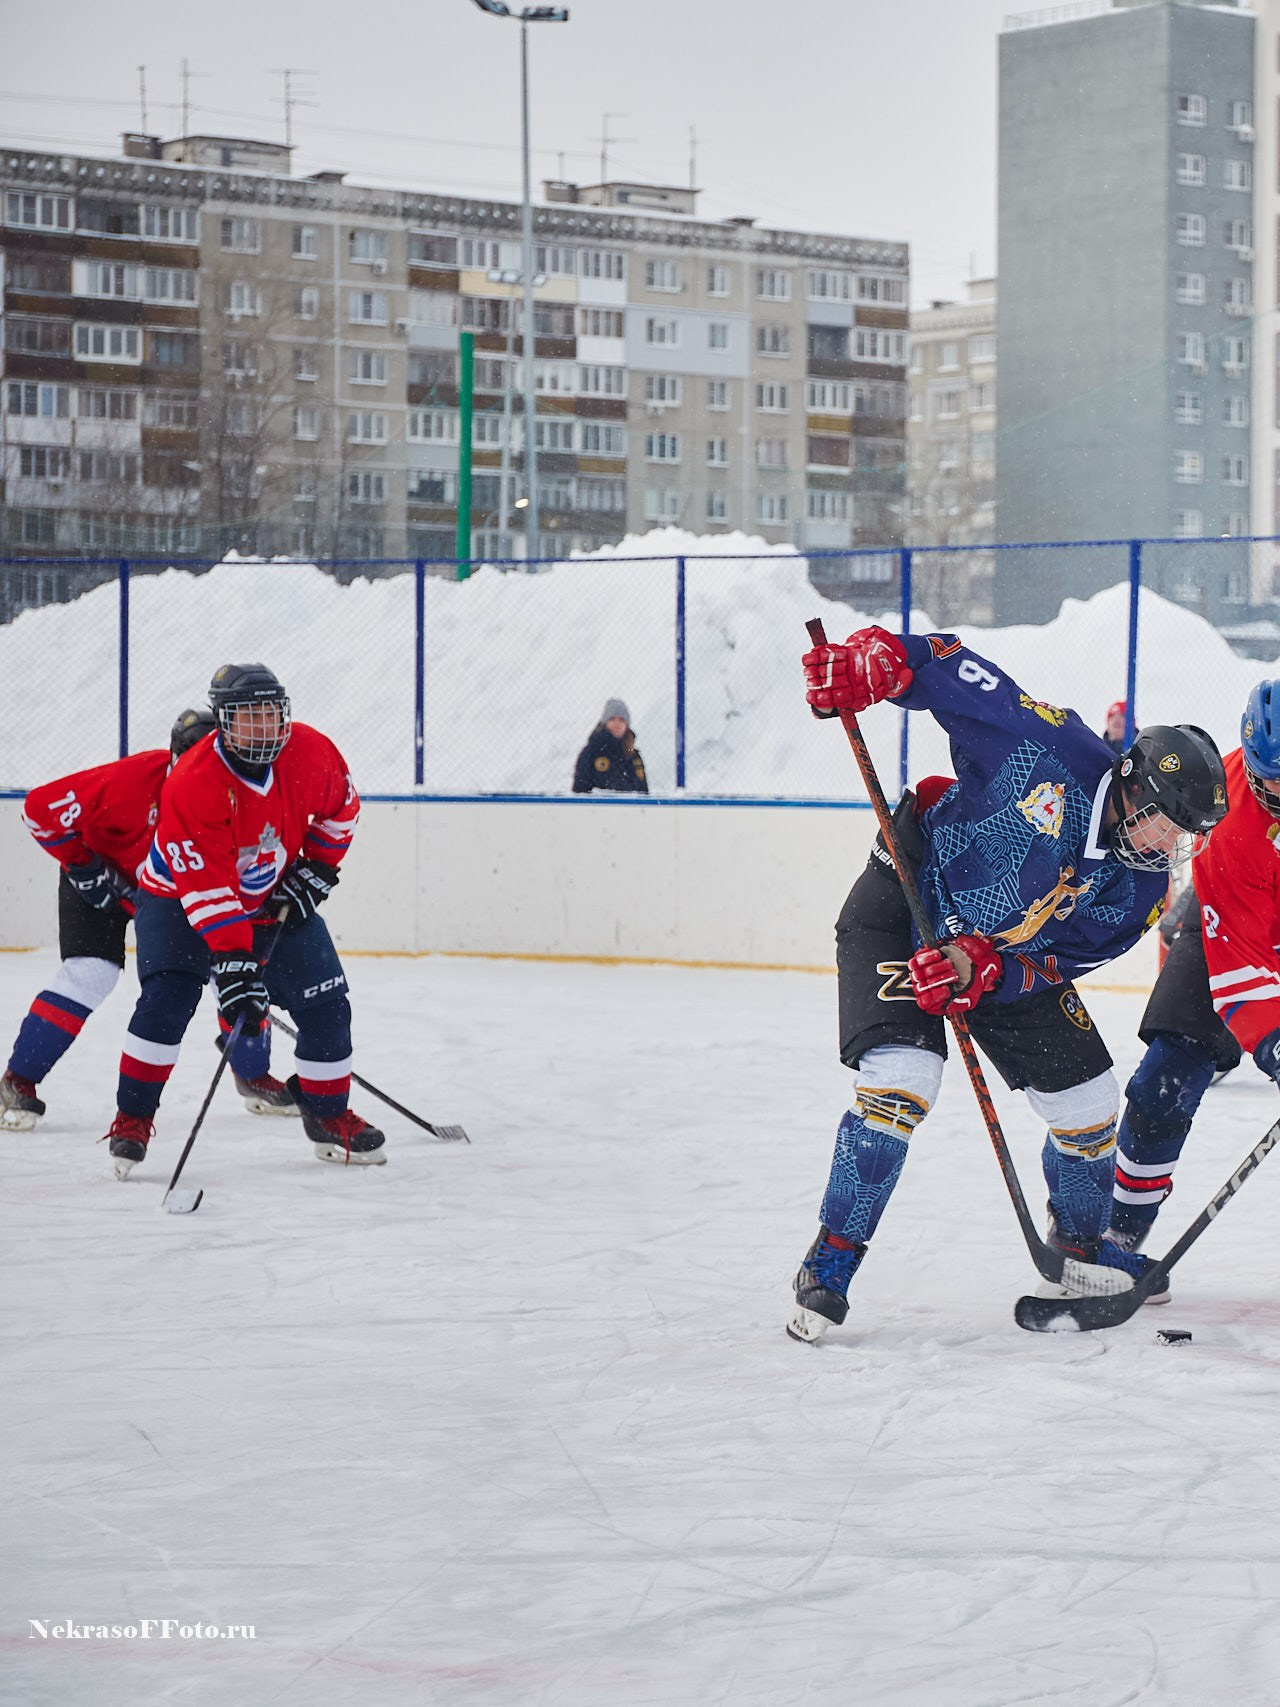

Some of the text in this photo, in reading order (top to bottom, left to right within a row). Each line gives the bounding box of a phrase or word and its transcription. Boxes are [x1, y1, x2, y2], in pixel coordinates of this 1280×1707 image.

[957, 658, 1001, 692] 9
[47, 789, 83, 828] 78
[165, 839, 205, 874] 85
[303, 973, 346, 999] CCM
